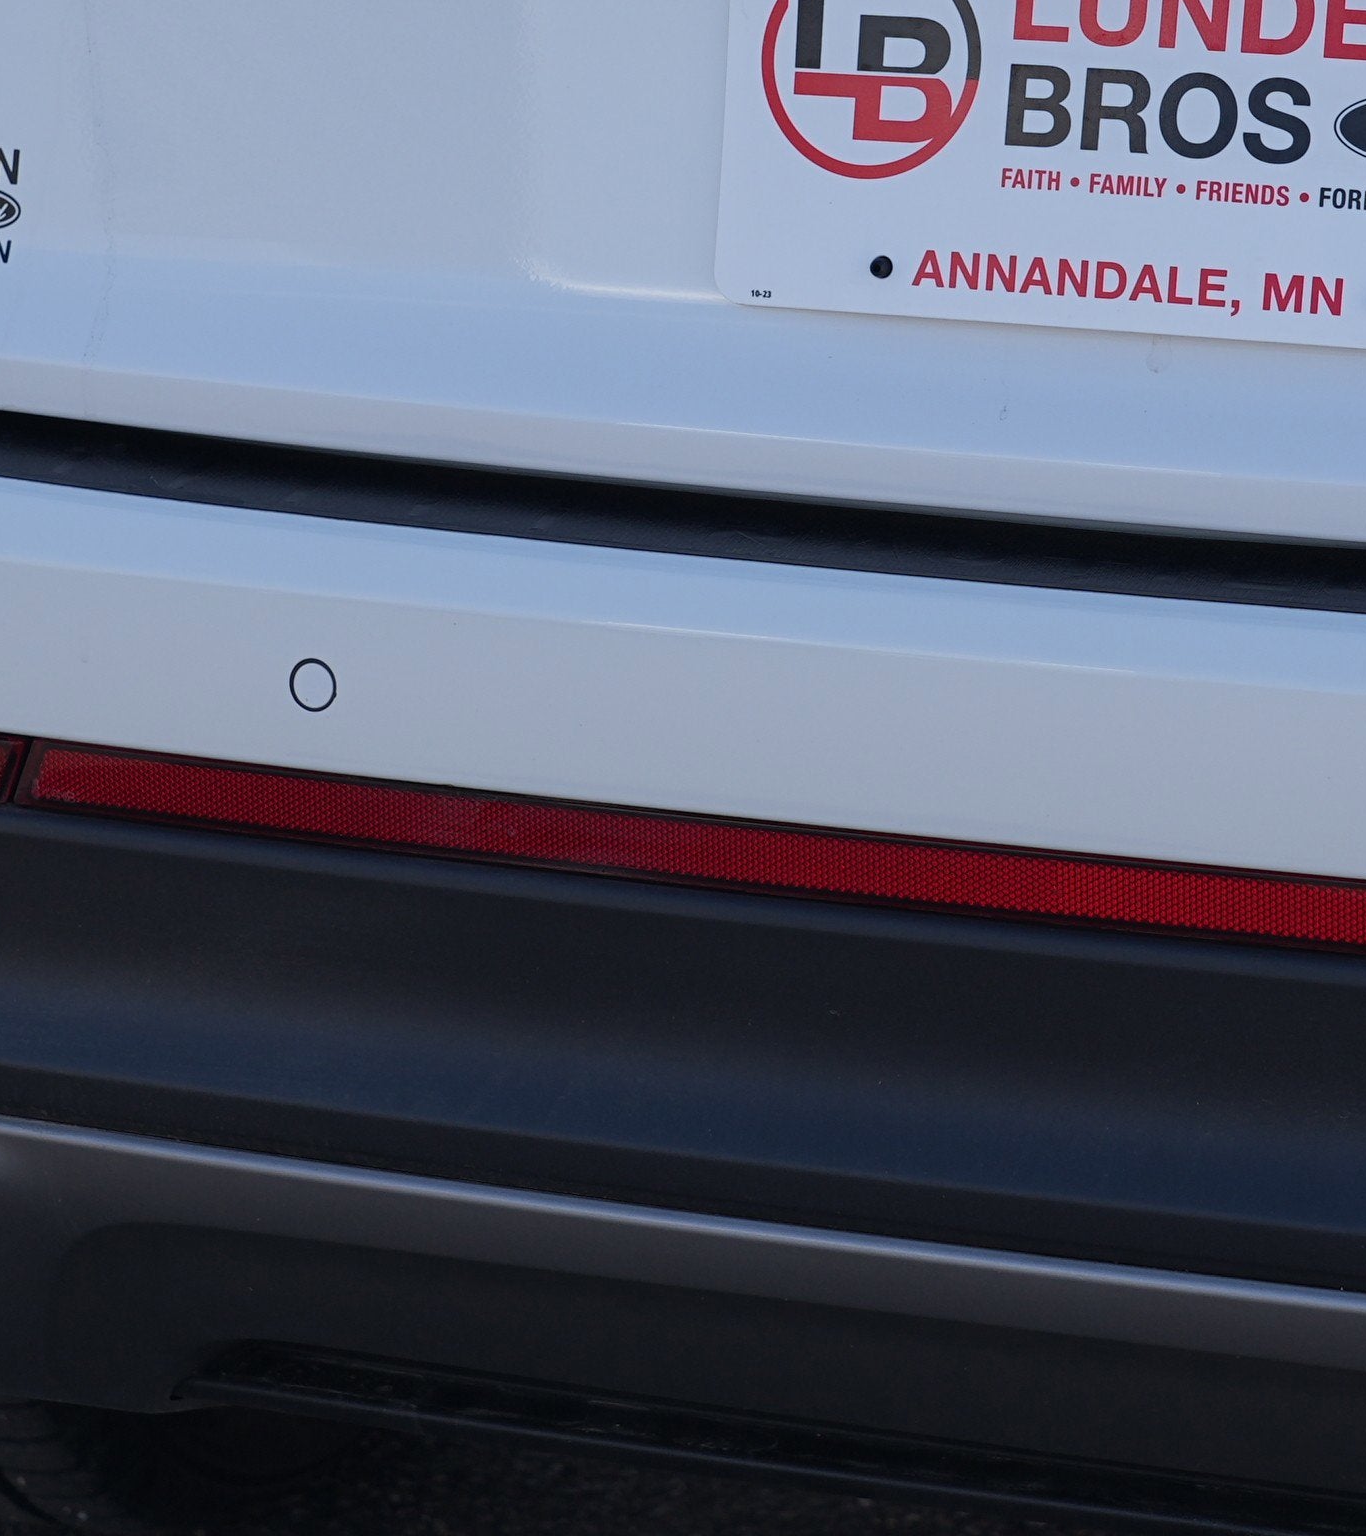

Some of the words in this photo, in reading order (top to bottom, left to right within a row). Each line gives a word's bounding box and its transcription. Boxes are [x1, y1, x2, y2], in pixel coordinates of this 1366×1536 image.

[1004, 63, 1312, 165] BROS
[1000, 167, 1061, 191] FAITH
[1088, 173, 1168, 198] FAMILY
[1195, 180, 1290, 207] FRIENDS
[751, 289, 772, 299] 10-23
[911, 249, 1241, 317] ANNANDALE,
[1261, 272, 1344, 317] MN
